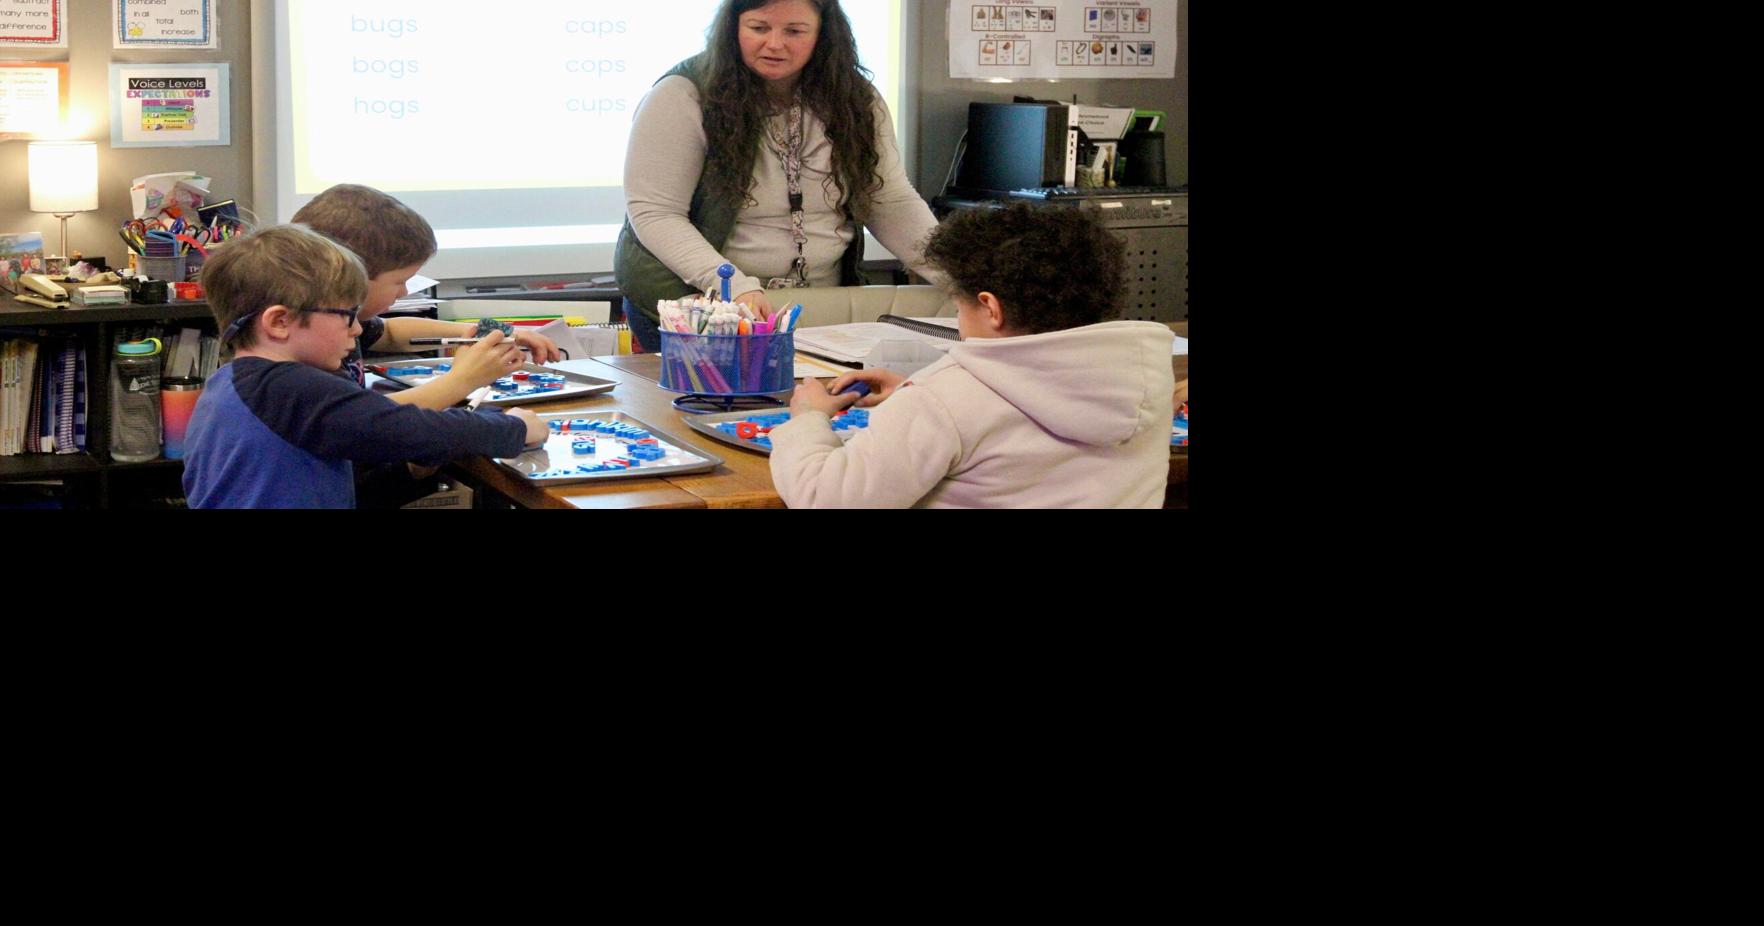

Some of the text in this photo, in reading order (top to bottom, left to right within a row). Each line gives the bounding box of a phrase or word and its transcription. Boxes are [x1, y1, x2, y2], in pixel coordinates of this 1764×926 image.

[351, 15, 418, 39] bugs
[565, 20, 627, 38] caps
[352, 56, 419, 79] bogs
[565, 59, 626, 77] cops
[131, 80, 204, 88] Voice Levels
[353, 96, 420, 119] hogs
[565, 98, 627, 116] cups
